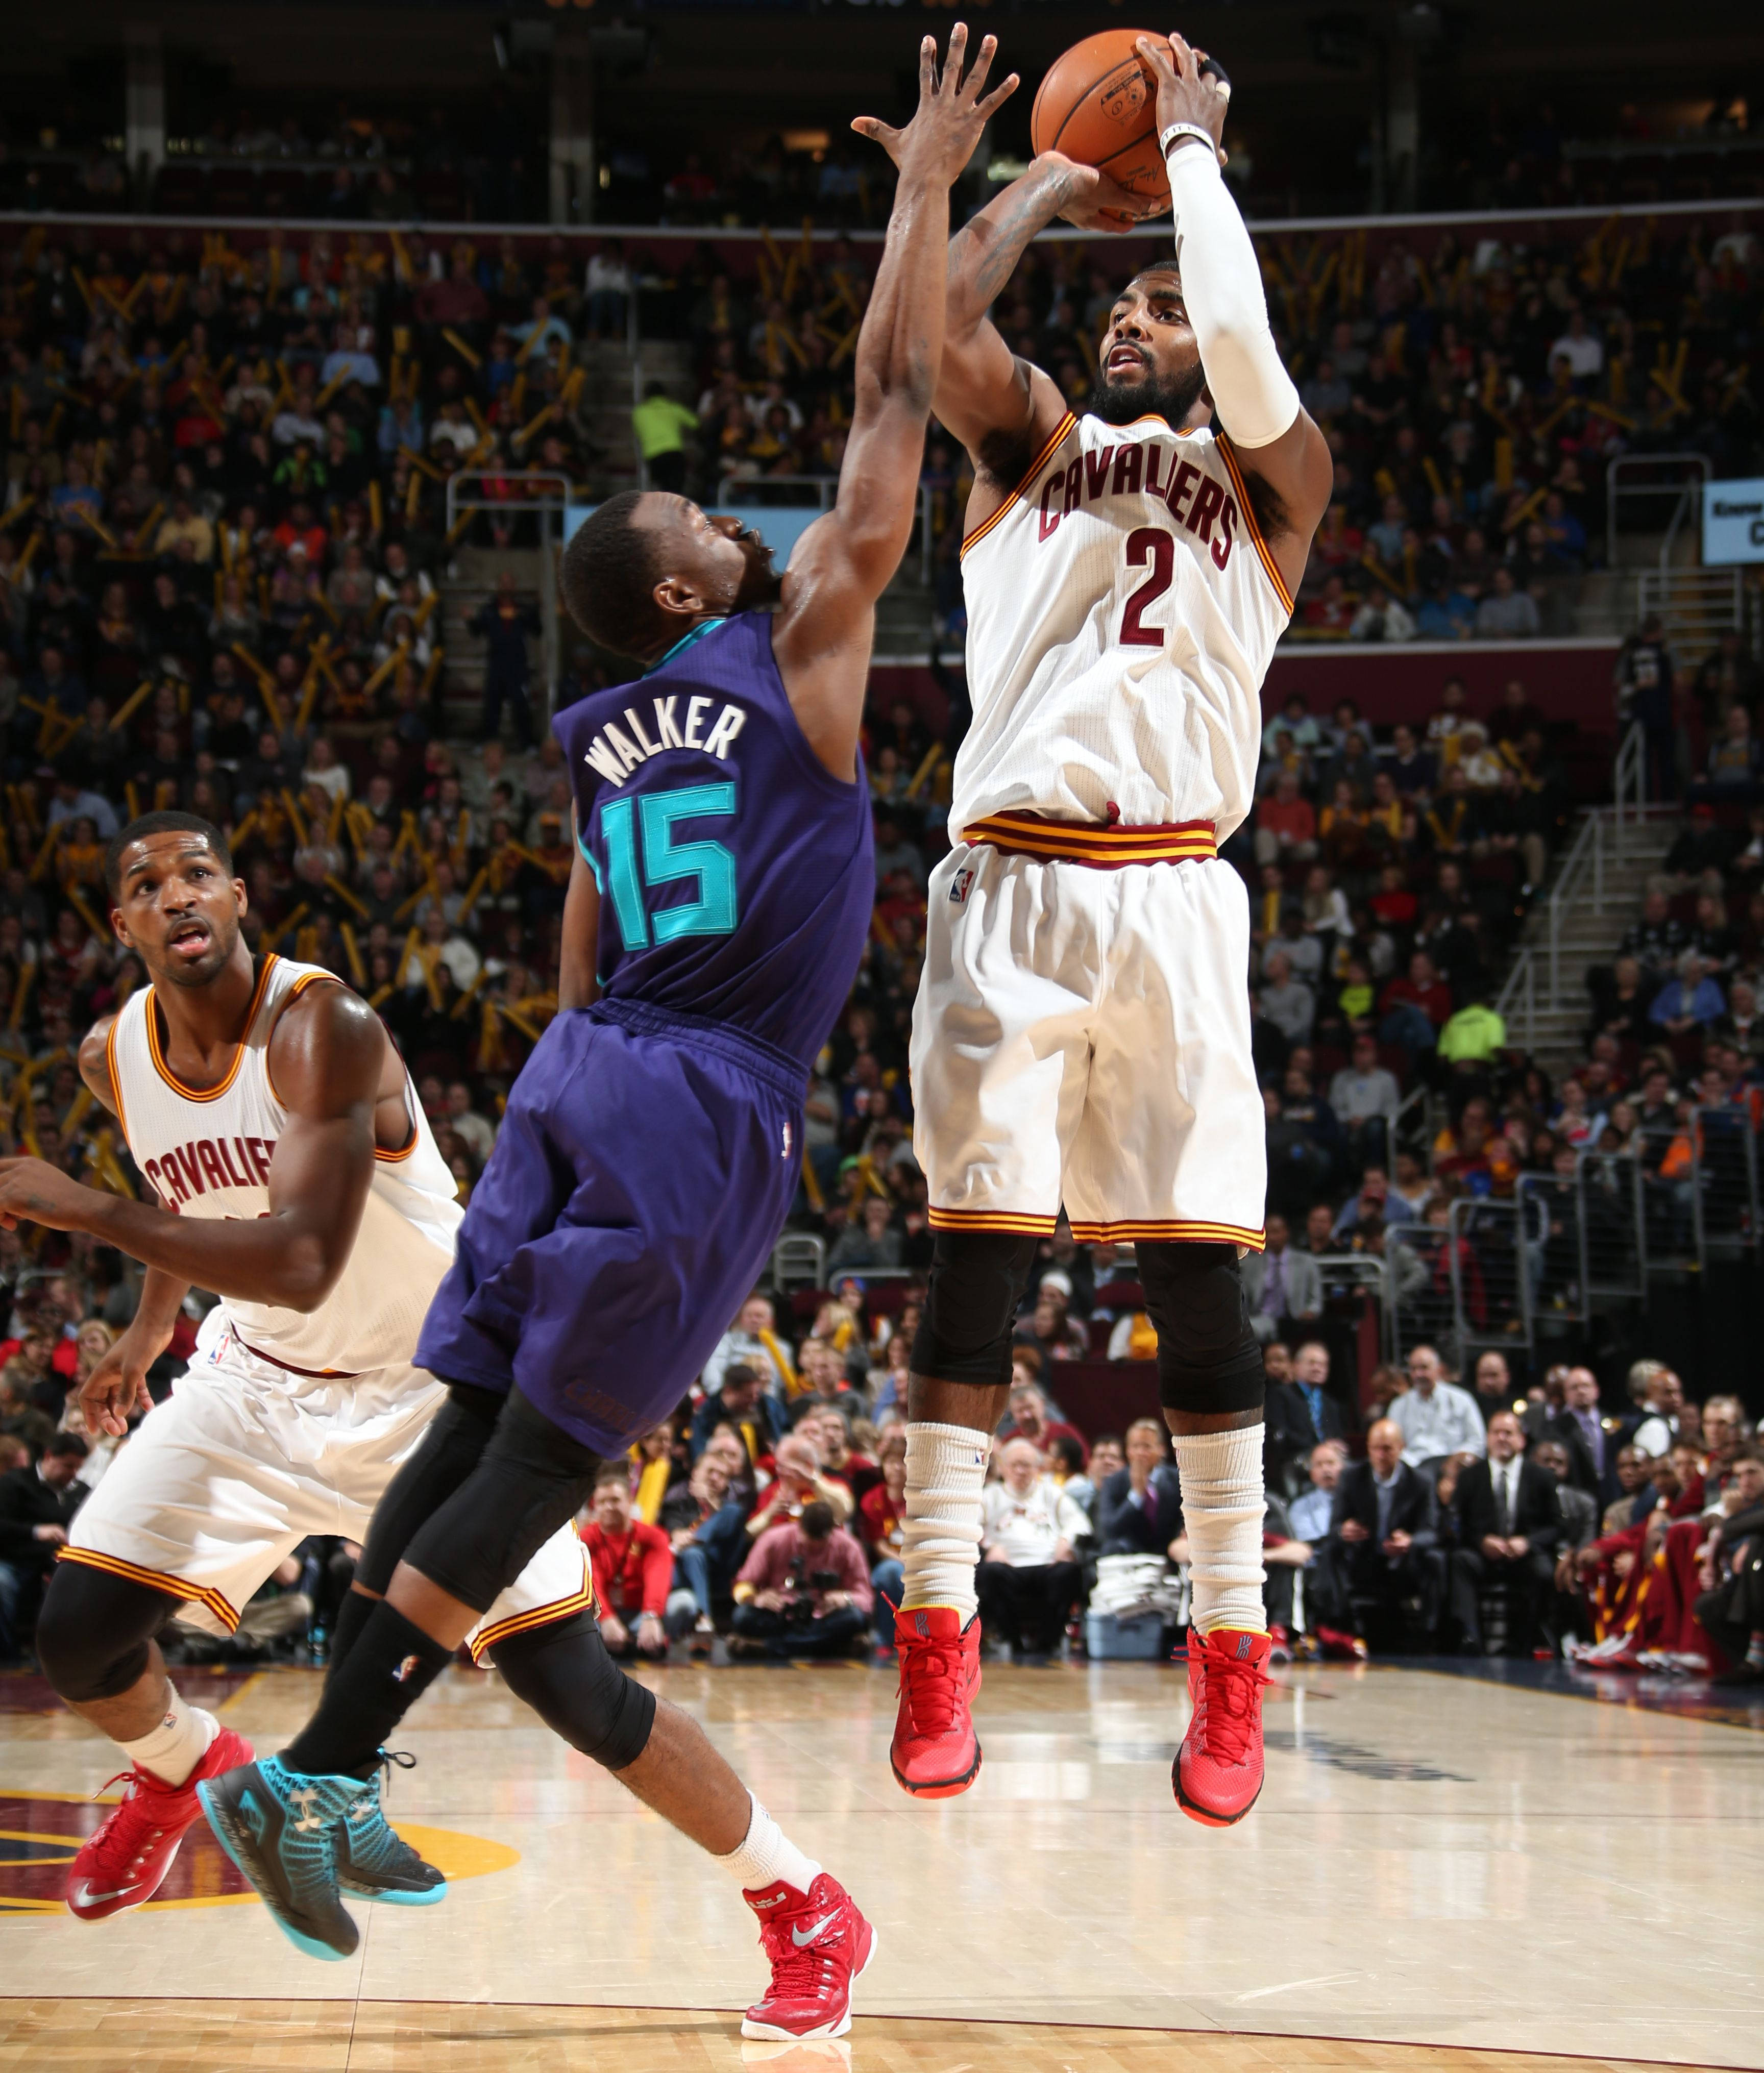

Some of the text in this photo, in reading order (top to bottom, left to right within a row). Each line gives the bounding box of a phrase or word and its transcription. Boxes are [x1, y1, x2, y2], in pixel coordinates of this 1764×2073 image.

[1038, 443, 1238, 572] CAVALIERS
[1119, 528, 1174, 646] 2
[584, 695, 748, 788] WALKER
[600, 781, 738, 952] 15
